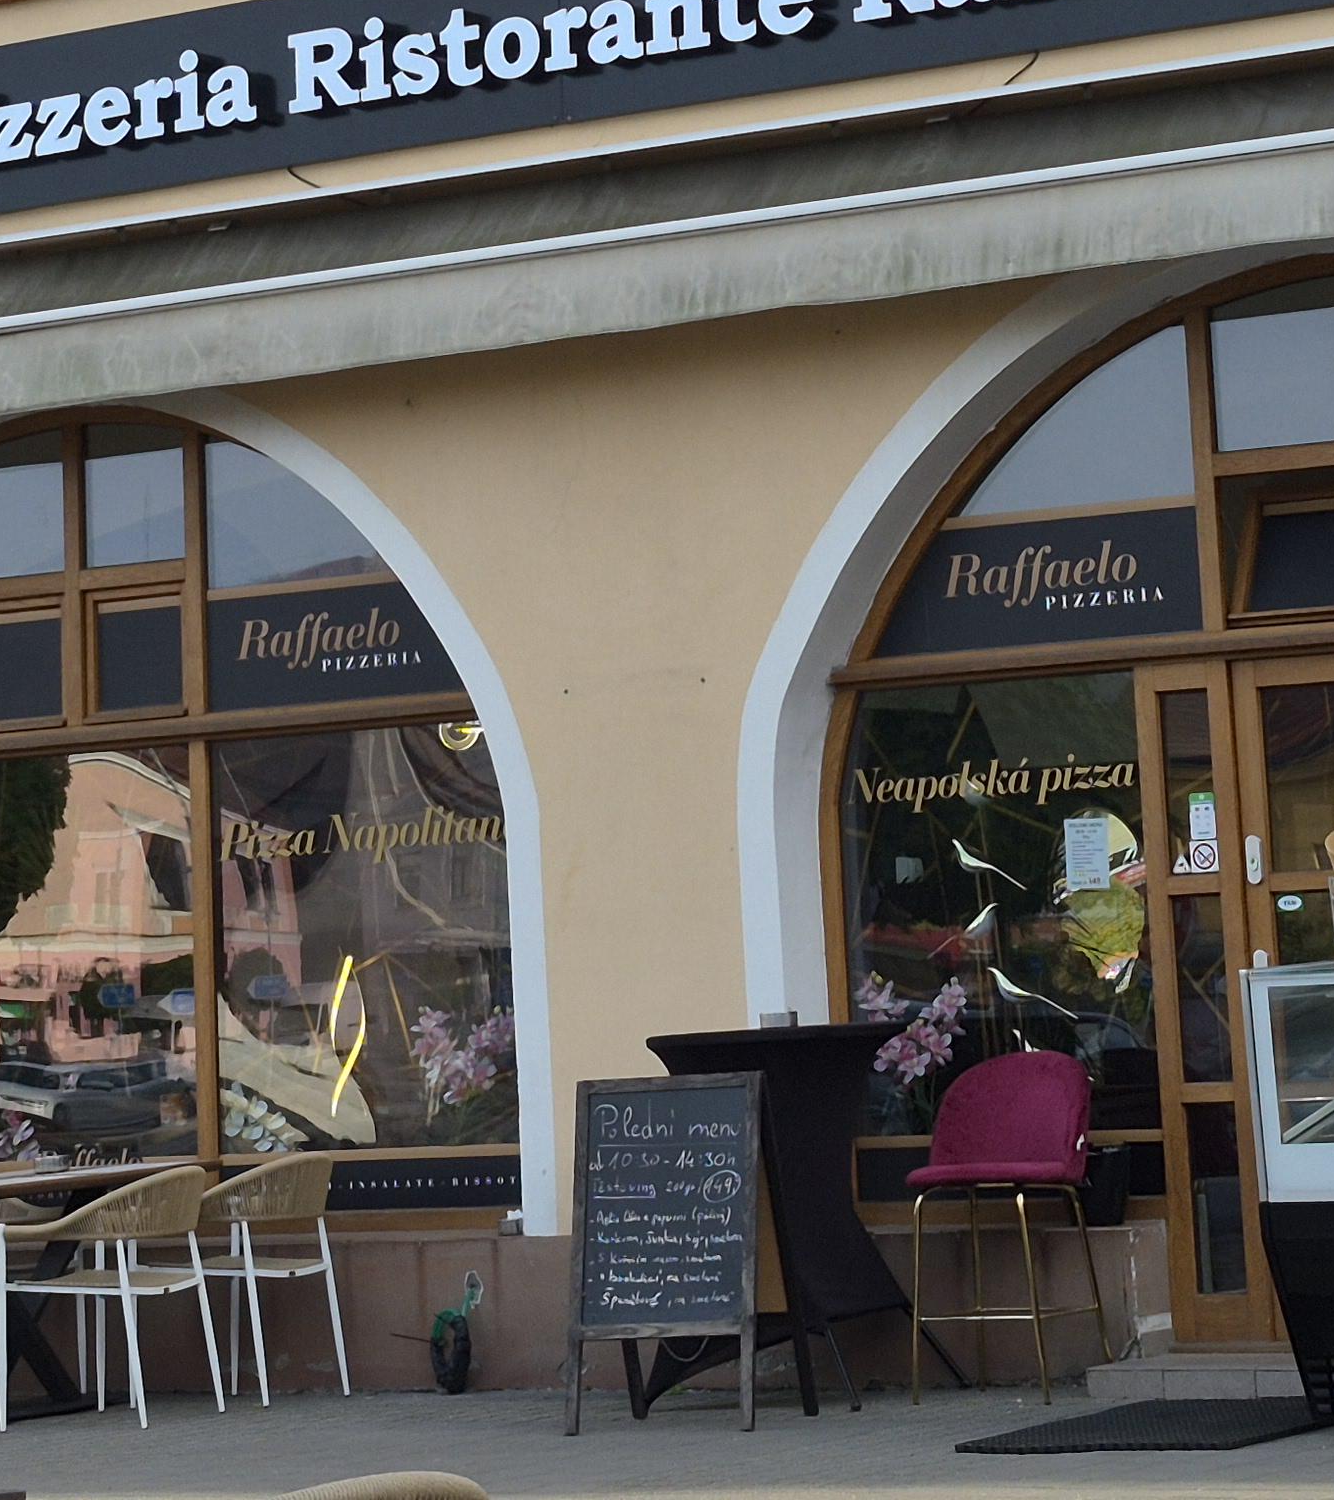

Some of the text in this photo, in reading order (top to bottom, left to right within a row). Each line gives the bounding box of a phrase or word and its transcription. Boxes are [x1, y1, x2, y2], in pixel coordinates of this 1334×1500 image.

[944, 539, 1137, 608] Raffaelo
[1045, 586, 1164, 611] PIZZERIA
[236, 607, 400, 670] Raffaelo
[321, 651, 422, 673] PIZZERIA
[848, 753, 1135, 813] Neapolská pizza
[220, 805, 506, 864] Pizza Napolitan
[689, 1121, 740, 1138] menu
[349, 1175, 516, 1190] INSALATE RISSOT
